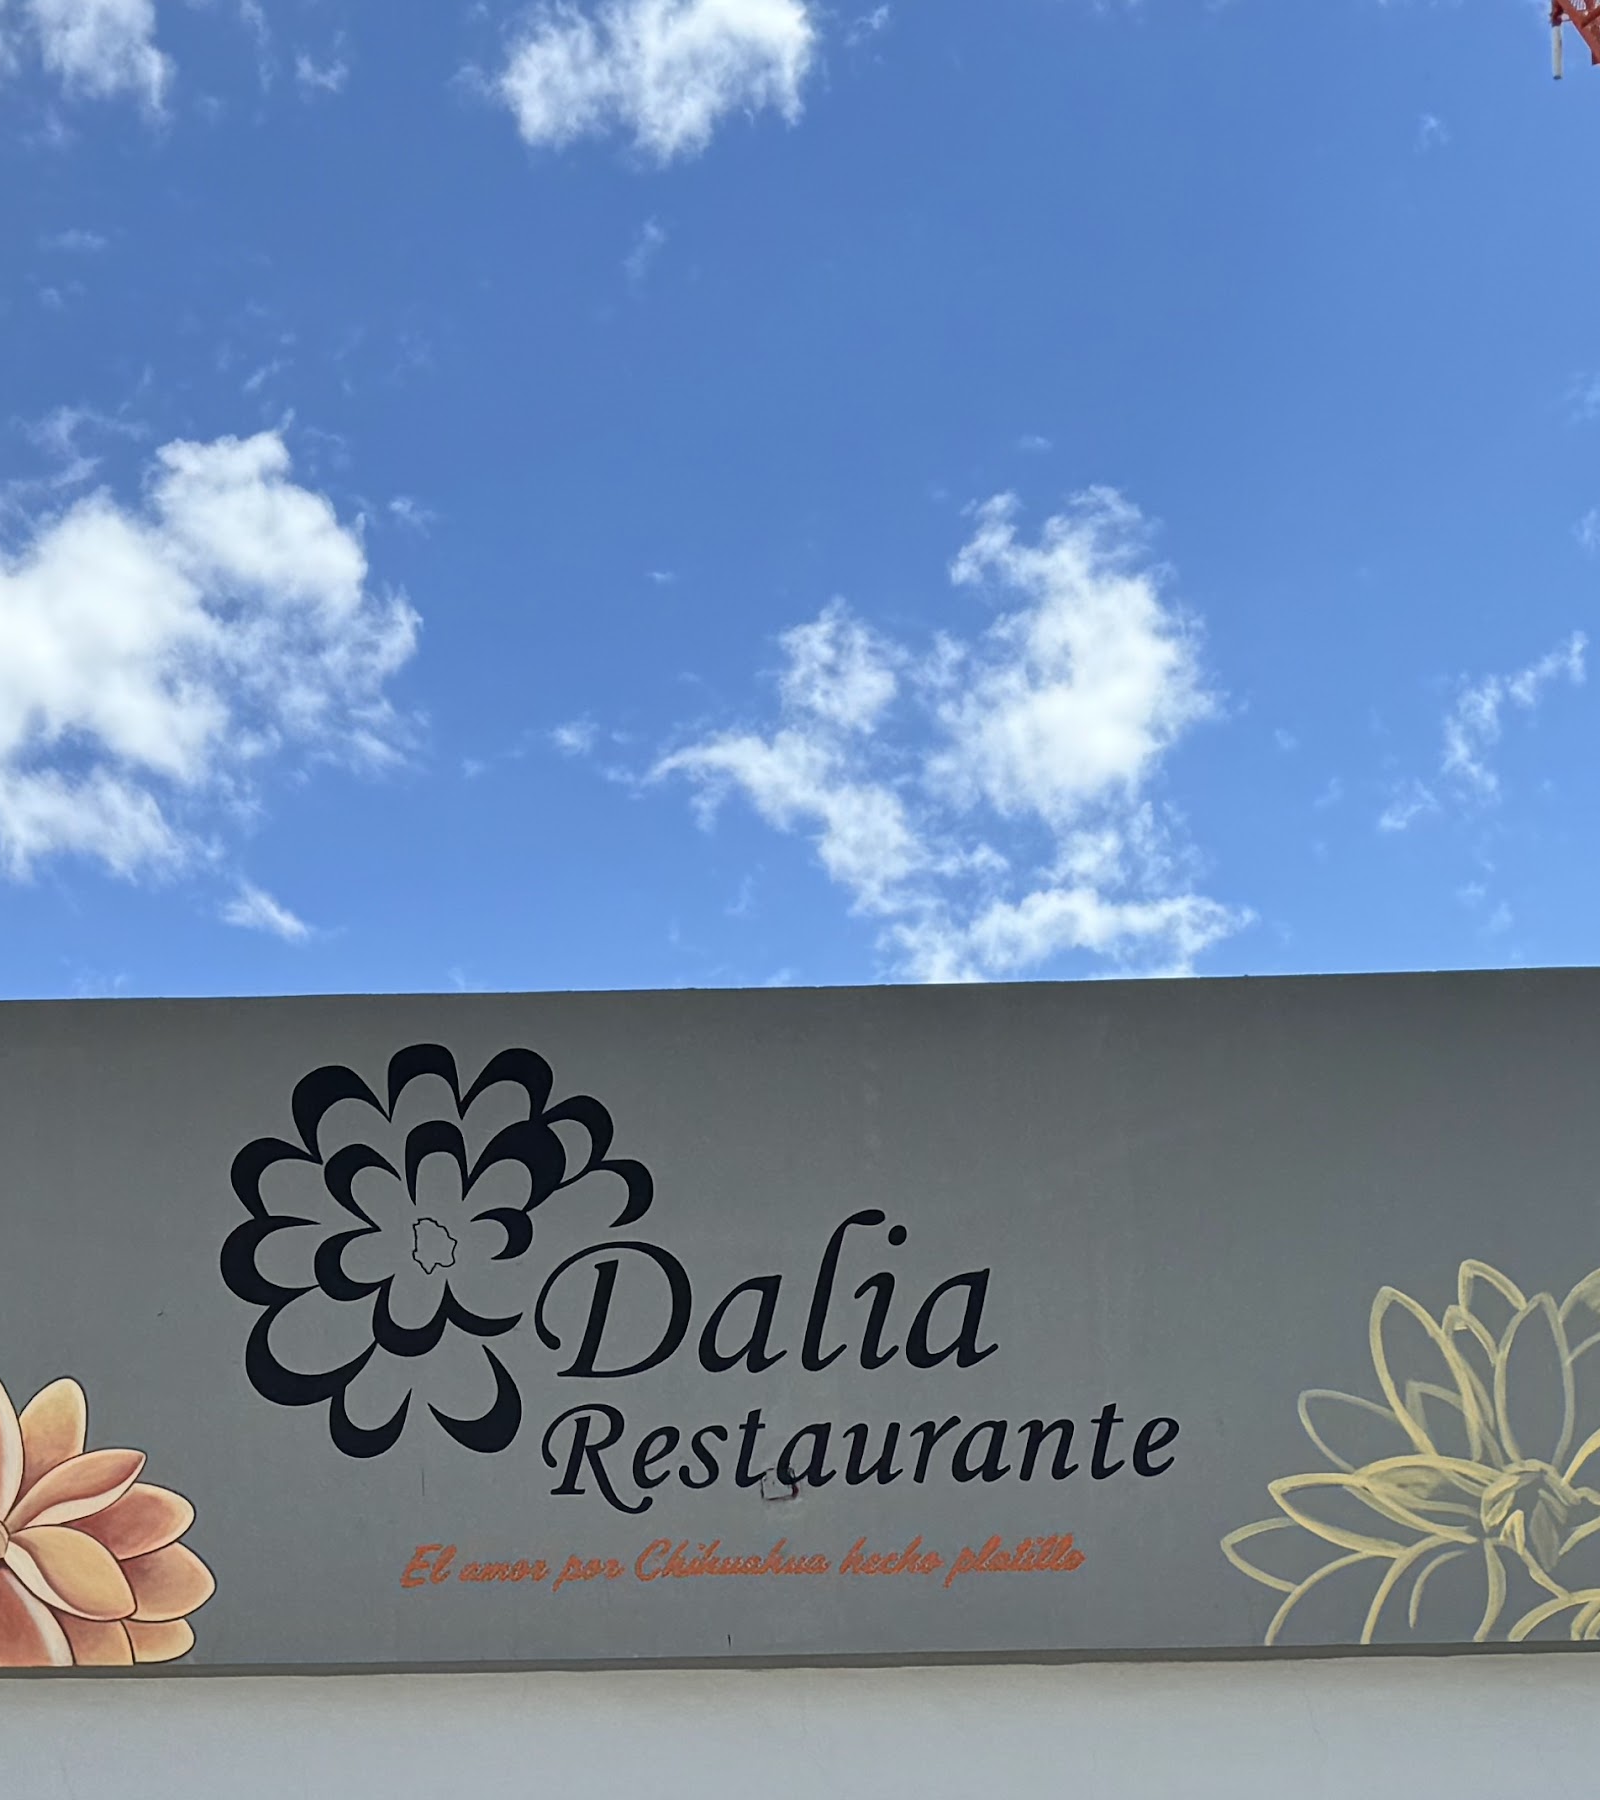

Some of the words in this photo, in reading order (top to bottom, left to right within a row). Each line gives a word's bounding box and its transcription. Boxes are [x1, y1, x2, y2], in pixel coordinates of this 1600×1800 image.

[534, 1208, 999, 1379] Dalia
[541, 1402, 1180, 1515] Restaurante
[400, 1543, 458, 1589] El
[458, 1559, 550, 1583] amor
[553, 1555, 625, 1592] por
[635, 1538, 831, 1582] Chihuahua
[839, 1536, 944, 1575] hecho
[943, 1534, 1086, 1589] platillo
